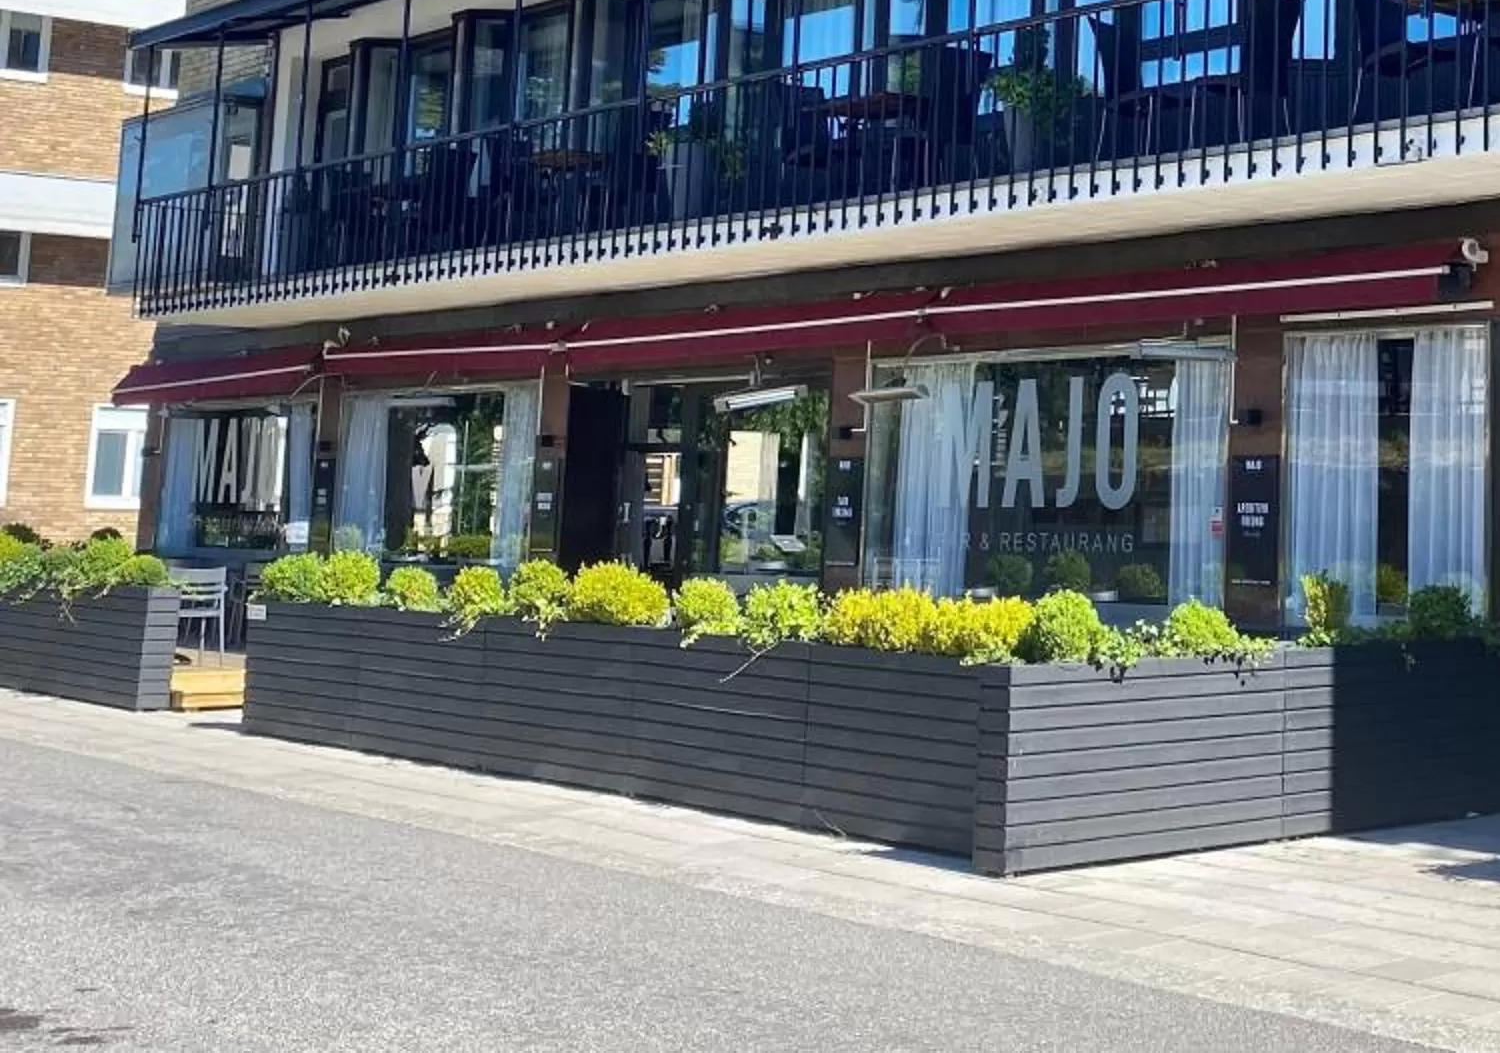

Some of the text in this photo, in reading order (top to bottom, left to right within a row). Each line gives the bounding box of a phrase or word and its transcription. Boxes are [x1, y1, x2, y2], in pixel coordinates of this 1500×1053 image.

[937, 372, 1139, 510] MAJO
[980, 534, 990, 551] &
[999, 531, 1135, 553] RESTAURANG
